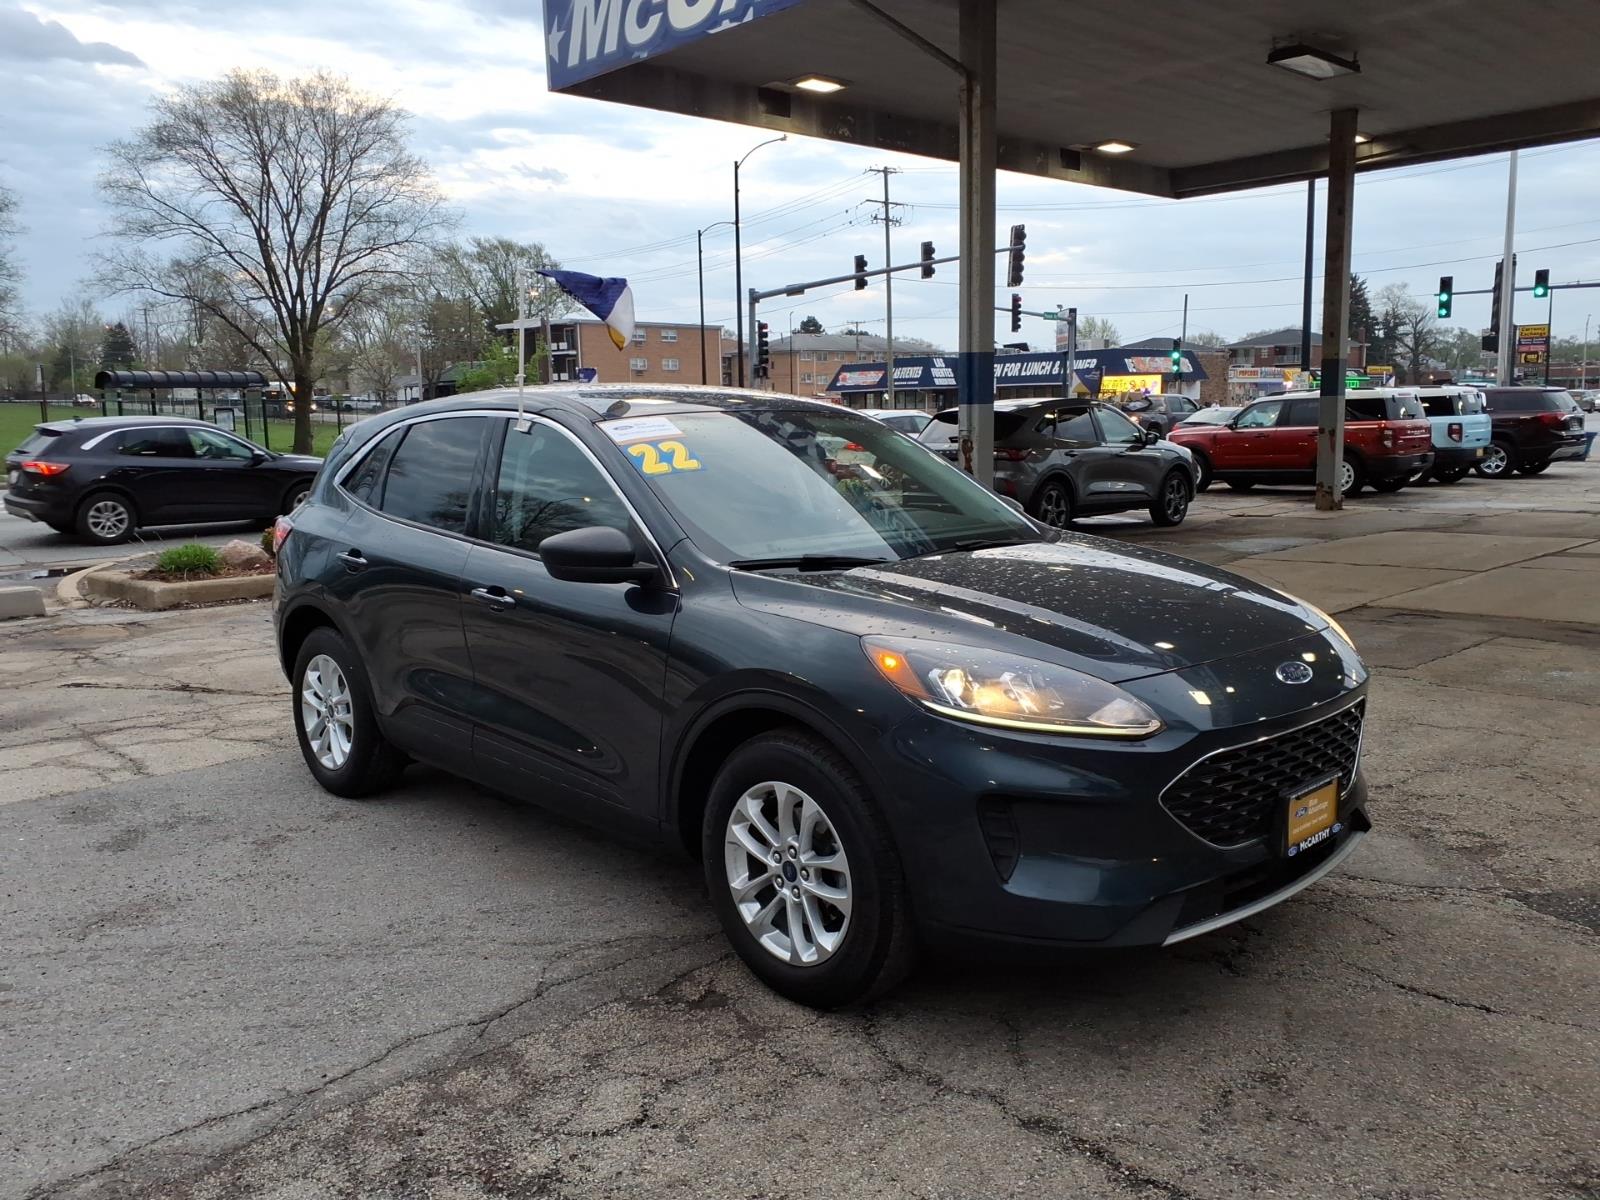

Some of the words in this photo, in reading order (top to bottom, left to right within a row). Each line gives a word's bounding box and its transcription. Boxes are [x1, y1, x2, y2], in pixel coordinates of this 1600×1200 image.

[1003, 363, 1021, 377] FOR
[1021, 361, 1053, 376] LUNCH
[1052, 360, 1060, 375] &
[1061, 358, 1097, 375] NNER
[627, 441, 702, 475] 22
[1299, 827, 1330, 852] McCARTHY
